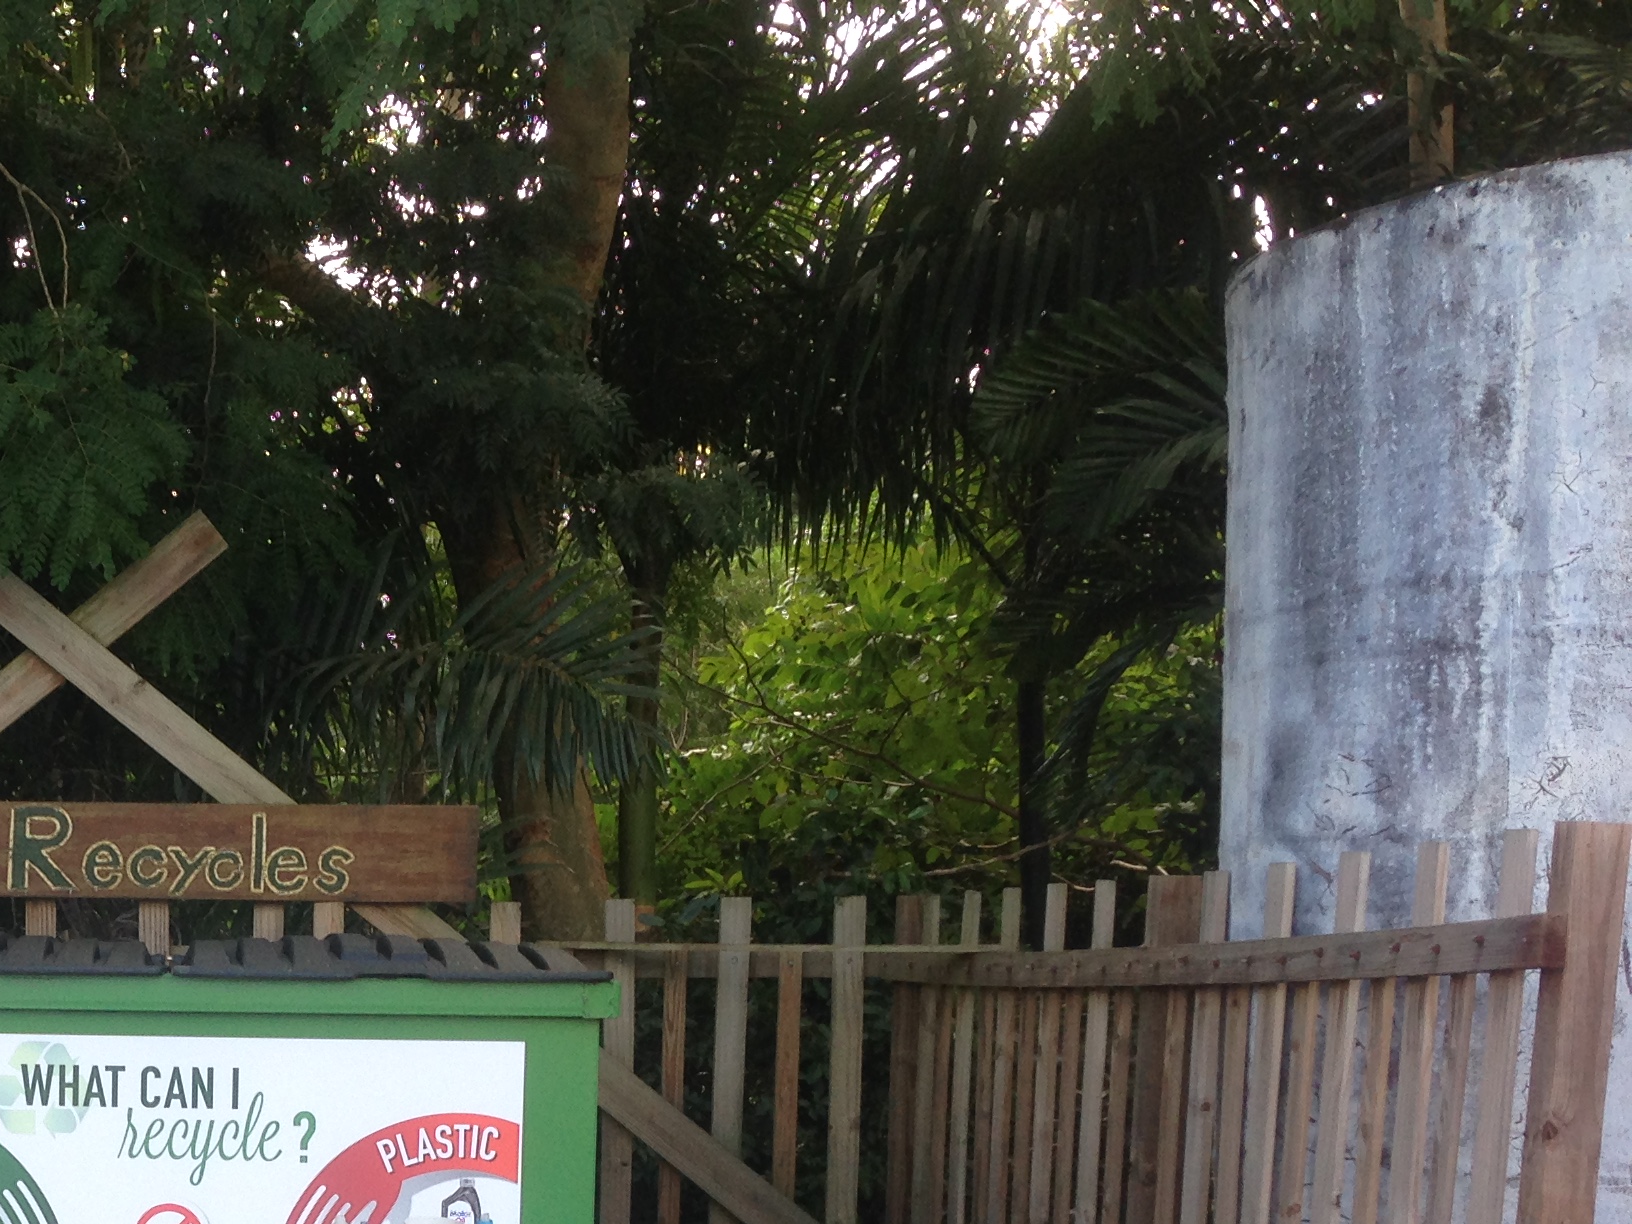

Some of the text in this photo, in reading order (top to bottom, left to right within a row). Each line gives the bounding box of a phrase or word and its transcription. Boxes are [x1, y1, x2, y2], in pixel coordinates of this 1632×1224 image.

[7, 805, 355, 897] Recycles
[20, 1063, 240, 1110] WHAT CAN I
[376, 1123, 500, 1174] PLASTIC
